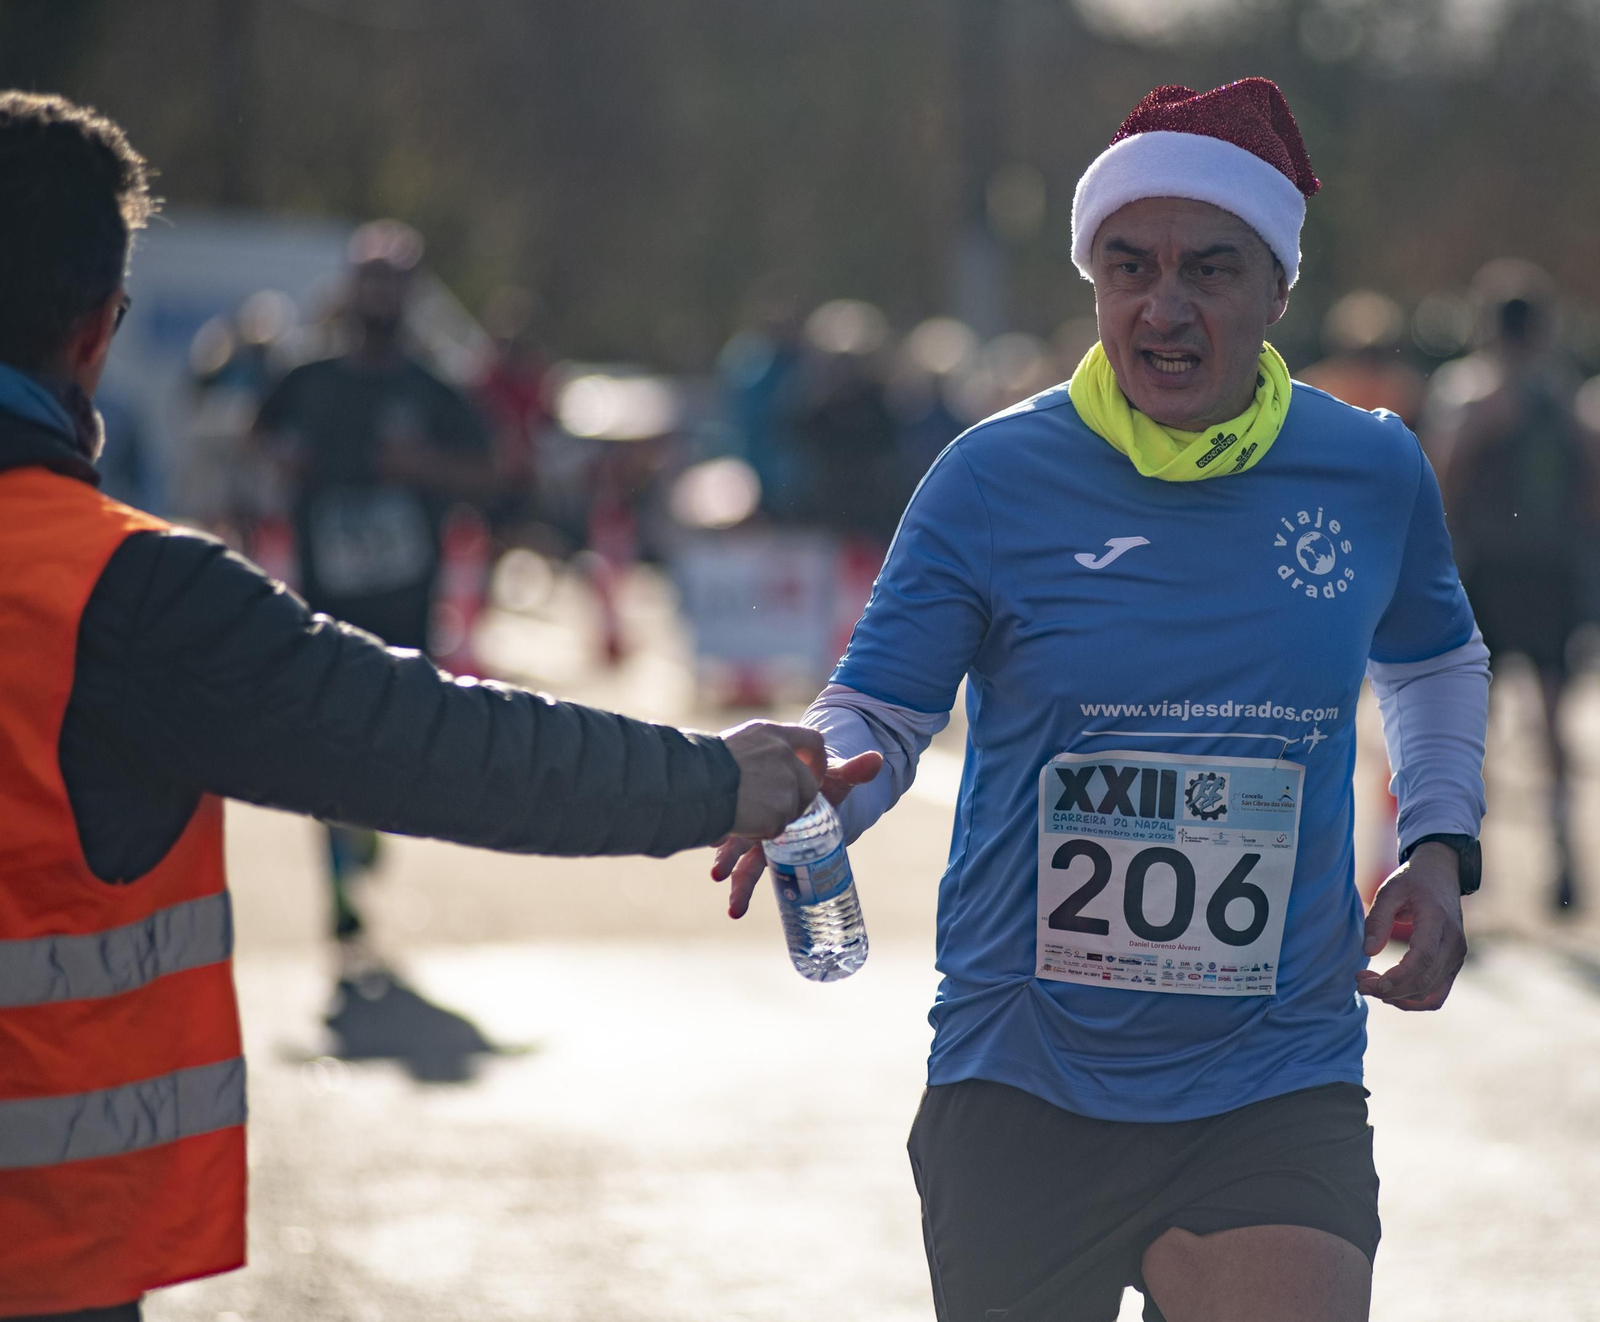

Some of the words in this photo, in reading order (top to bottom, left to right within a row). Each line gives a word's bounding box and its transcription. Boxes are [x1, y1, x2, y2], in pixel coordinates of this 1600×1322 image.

[1198, 434, 1236, 467] ecoembes
[1274, 507, 1352, 554] viajes
[1277, 565, 1355, 599] drados
[1080, 699, 1339, 722] www.viajesdrados.com
[1054, 765, 1178, 820] XXII
[1053, 812, 1107, 825] CARREIRA
[1113, 818, 1128, 828] DO
[1134, 819, 1175, 831] NADAL
[1081, 826, 1130, 837] decembro
[1148, 832, 1175, 840] 2025
[1048, 838, 1269, 947] 206
[1129, 940, 1150, 948] Daniel
[1177, 942, 1201, 951] Álvarez
